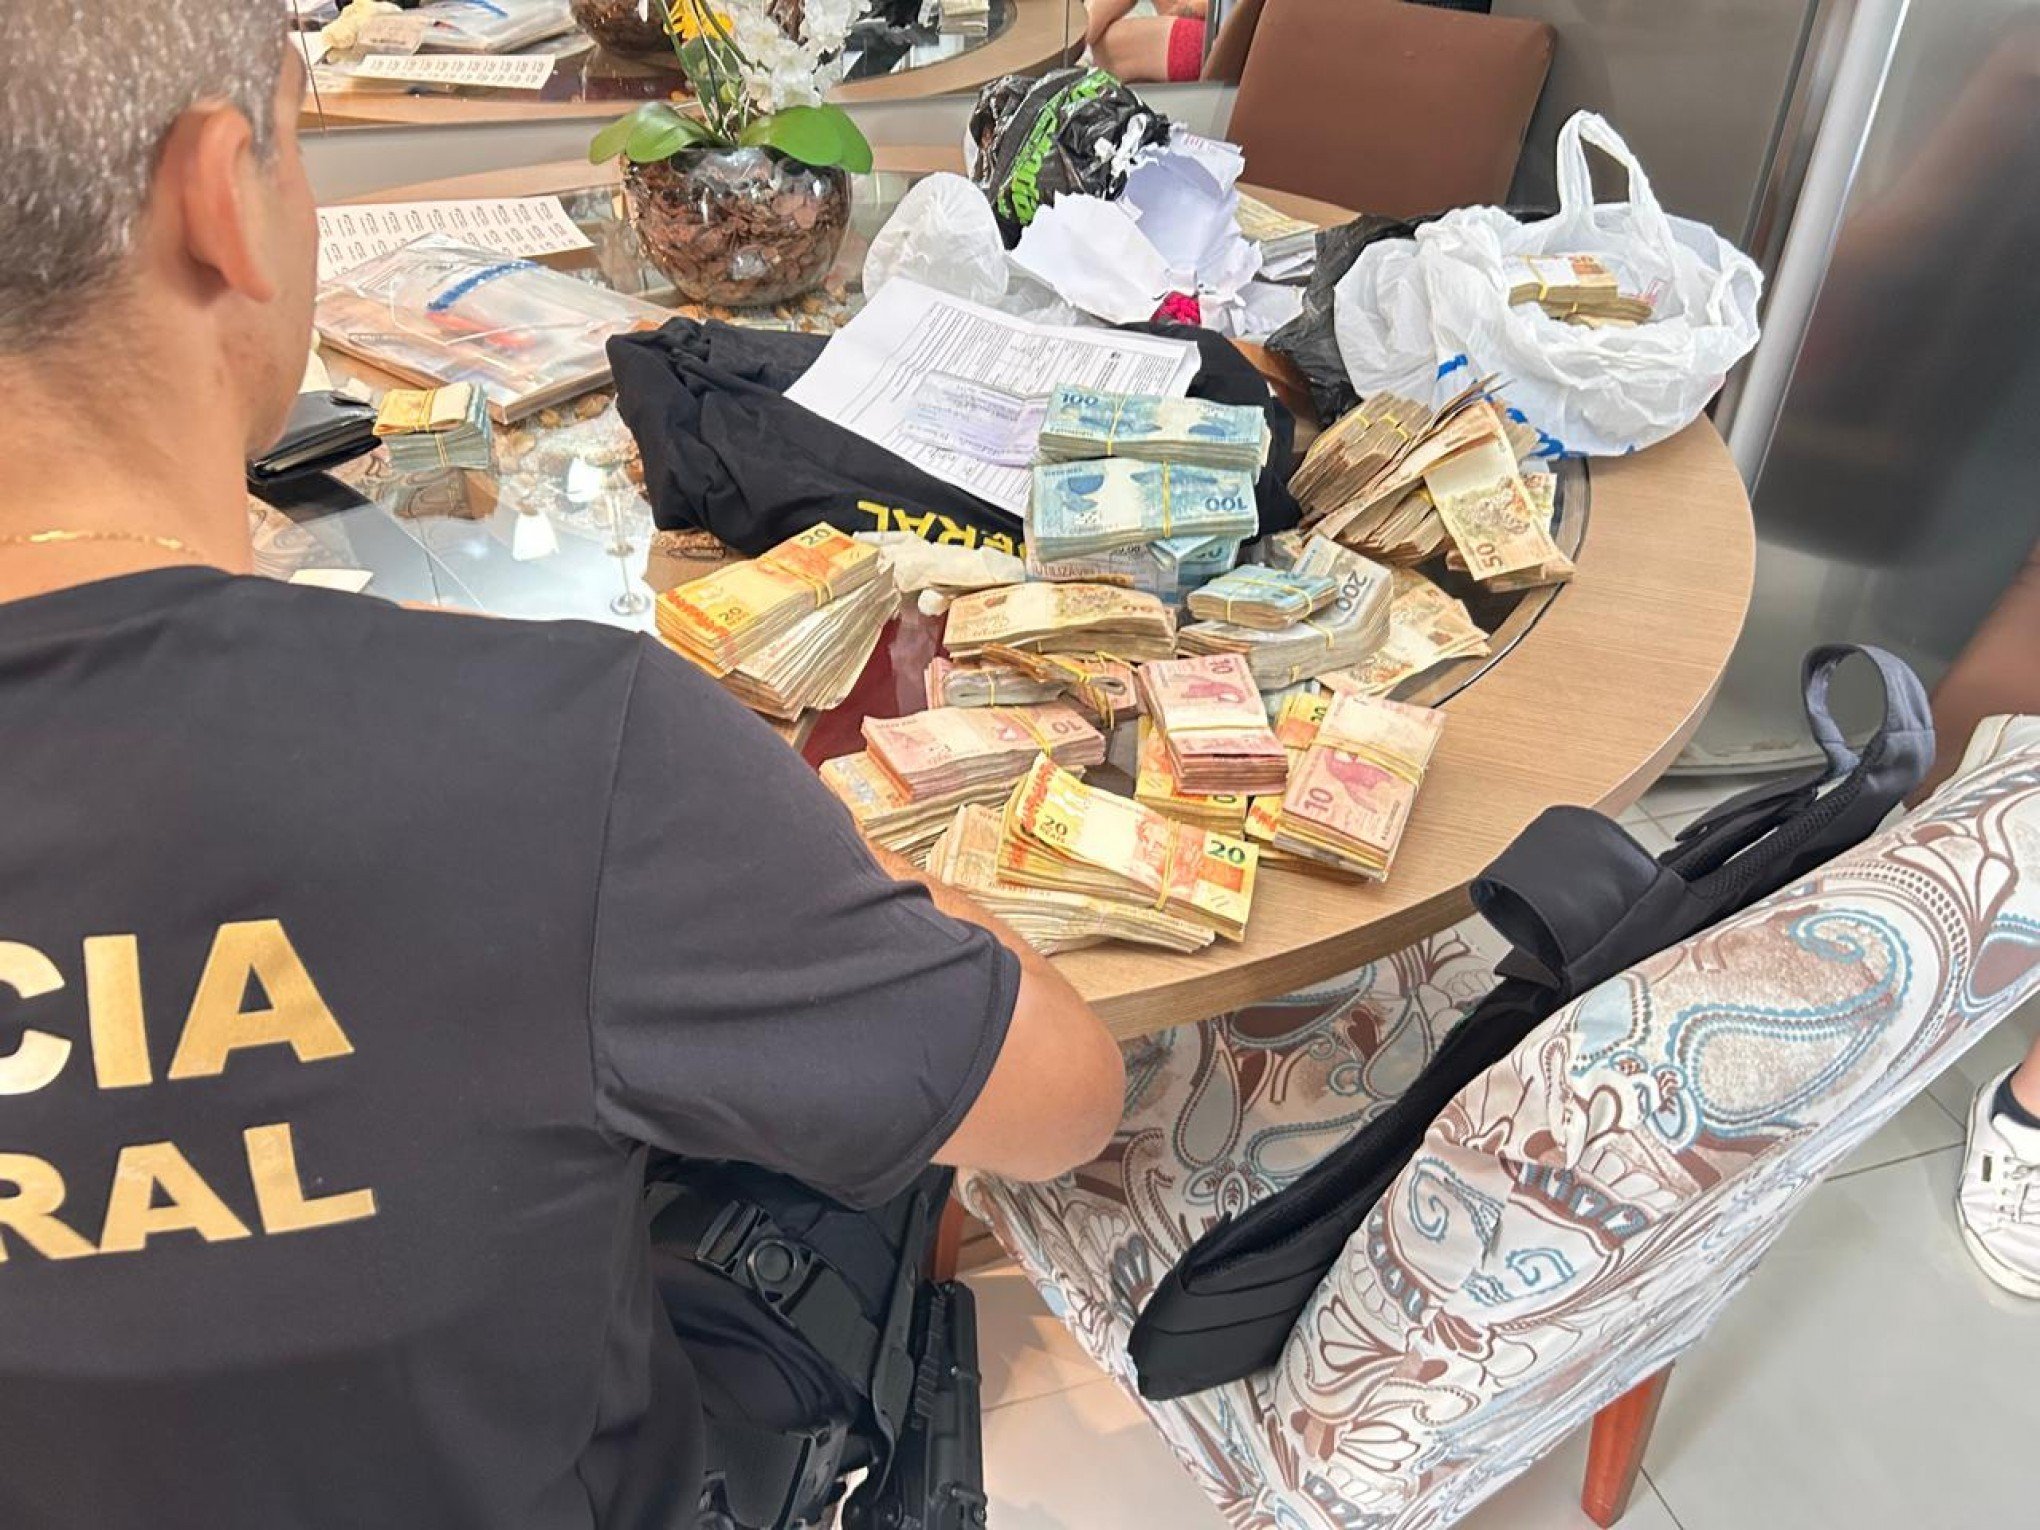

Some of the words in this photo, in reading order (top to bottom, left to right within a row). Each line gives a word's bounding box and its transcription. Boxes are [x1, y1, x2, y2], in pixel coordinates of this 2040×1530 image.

[1061, 392, 1099, 408] 100
[1203, 497, 1248, 512] 100
[800, 527, 833, 547] 20
[1475, 541, 1503, 569] 50
[1334, 569, 1369, 612] 200
[1302, 786, 1334, 814] 10
[1042, 814, 1069, 836] 20
[1207, 838, 1246, 865] 20
